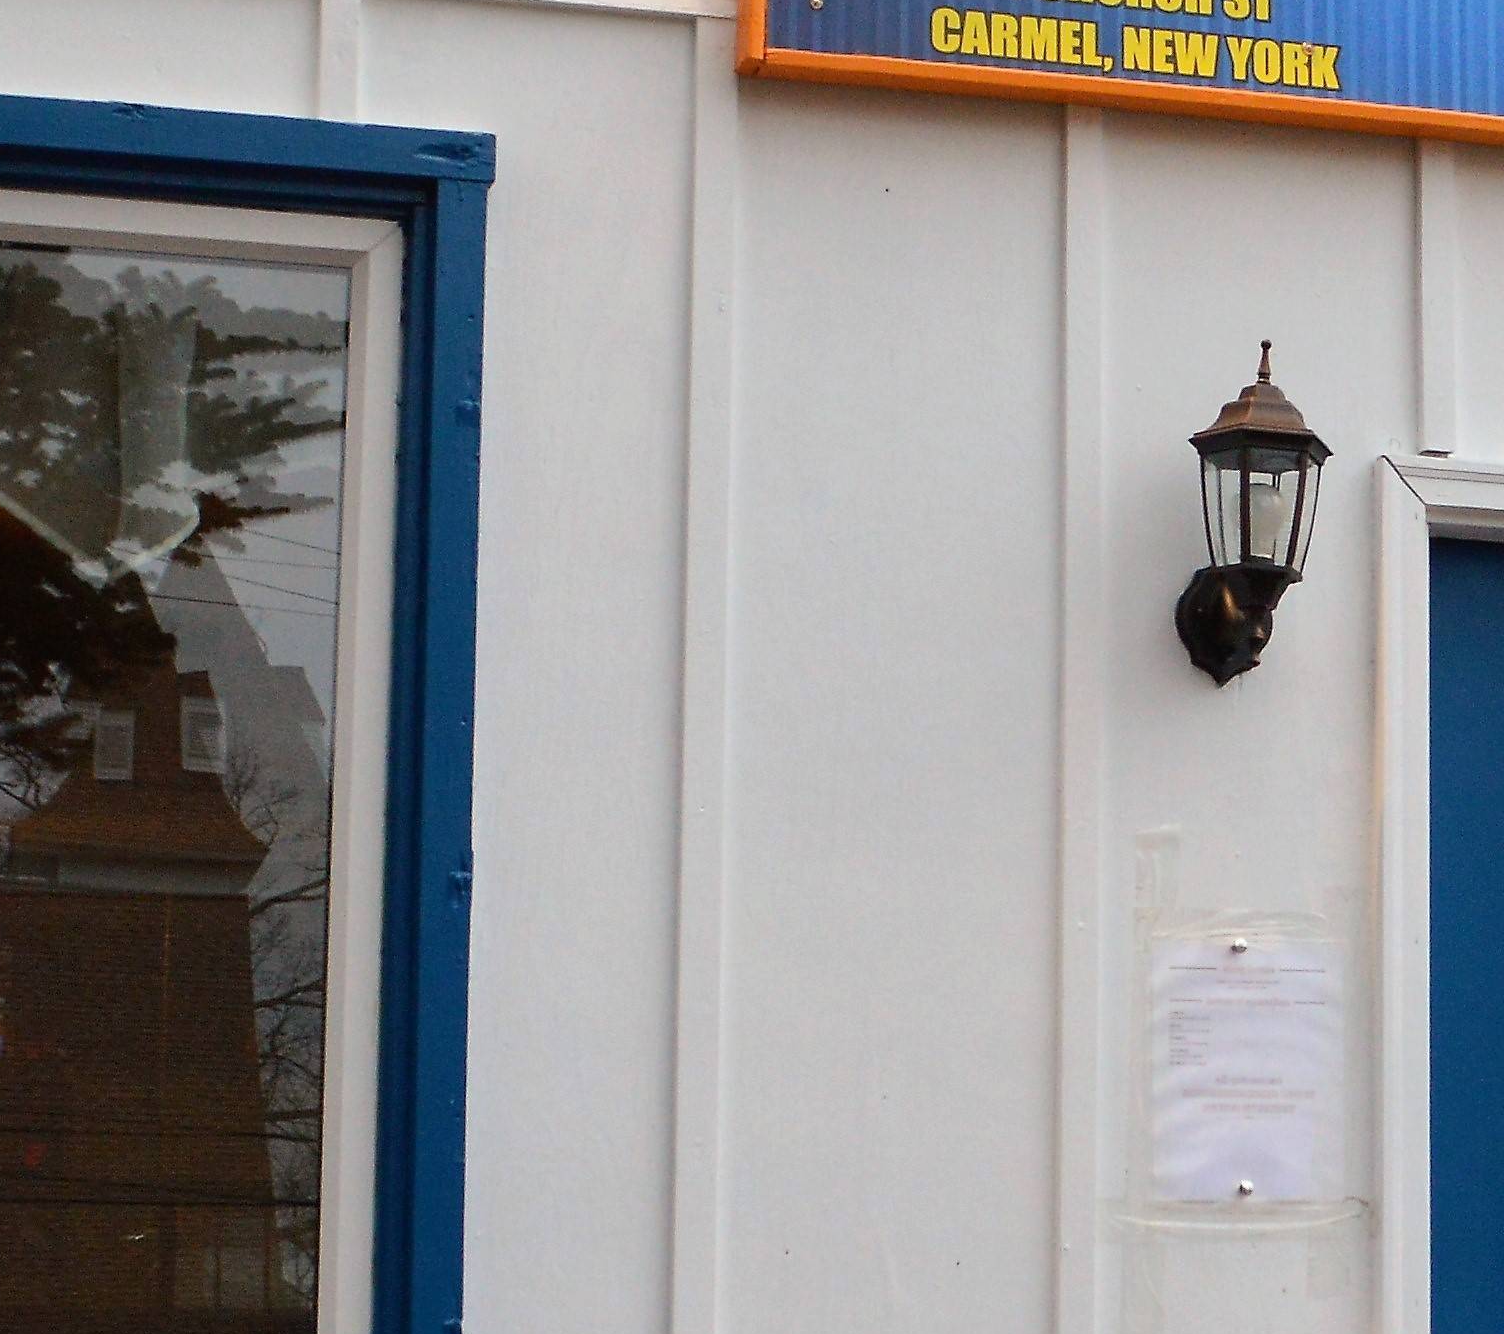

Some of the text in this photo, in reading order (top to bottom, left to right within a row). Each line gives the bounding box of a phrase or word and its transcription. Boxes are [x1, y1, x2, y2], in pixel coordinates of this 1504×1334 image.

[930, 8, 1342, 91] CARMEL, NEW YORK
